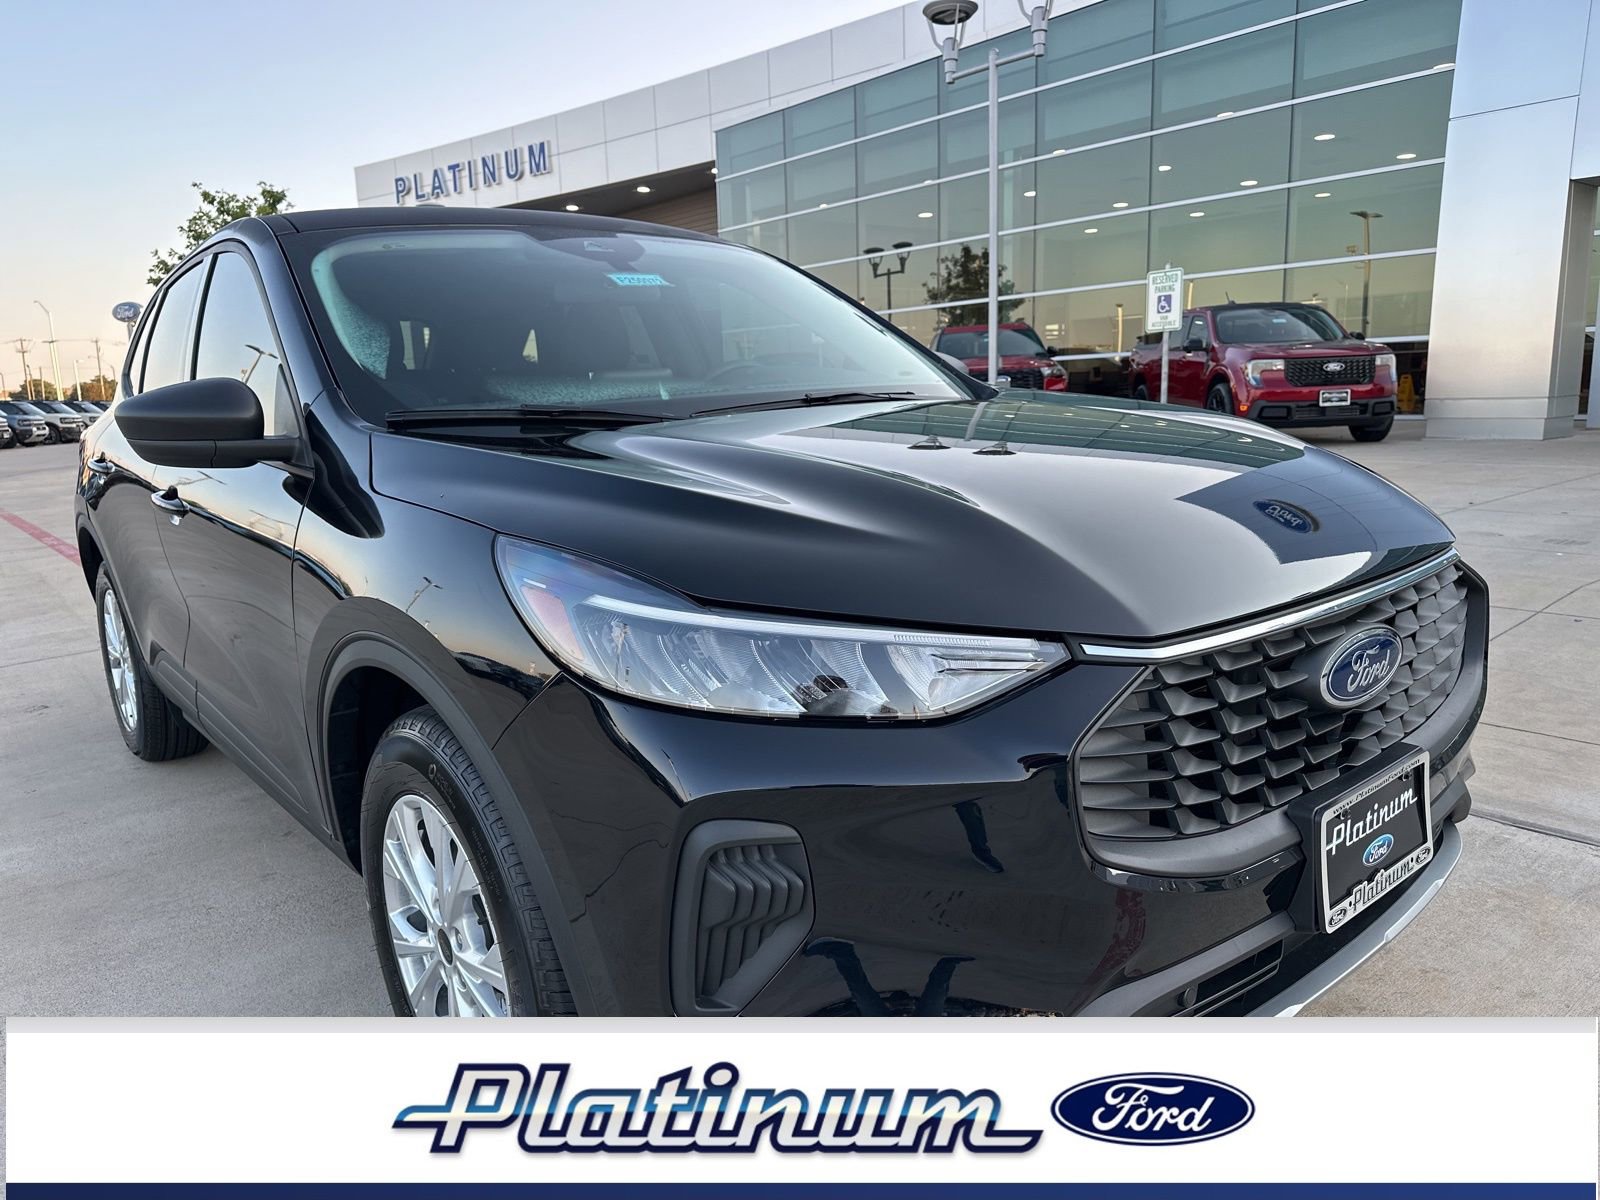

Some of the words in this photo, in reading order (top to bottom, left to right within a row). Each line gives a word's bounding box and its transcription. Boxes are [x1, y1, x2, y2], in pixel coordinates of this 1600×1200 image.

[394, 141, 549, 204] PLATINUM
[1151, 273, 1178, 285] RESERVED
[1154, 284, 1175, 294] PARKING
[1347, 644, 1390, 692] Ford
[1325, 788, 1418, 855] Platinum
[1369, 839, 1389, 863] Ford
[1352, 869, 1415, 912] Platinum
